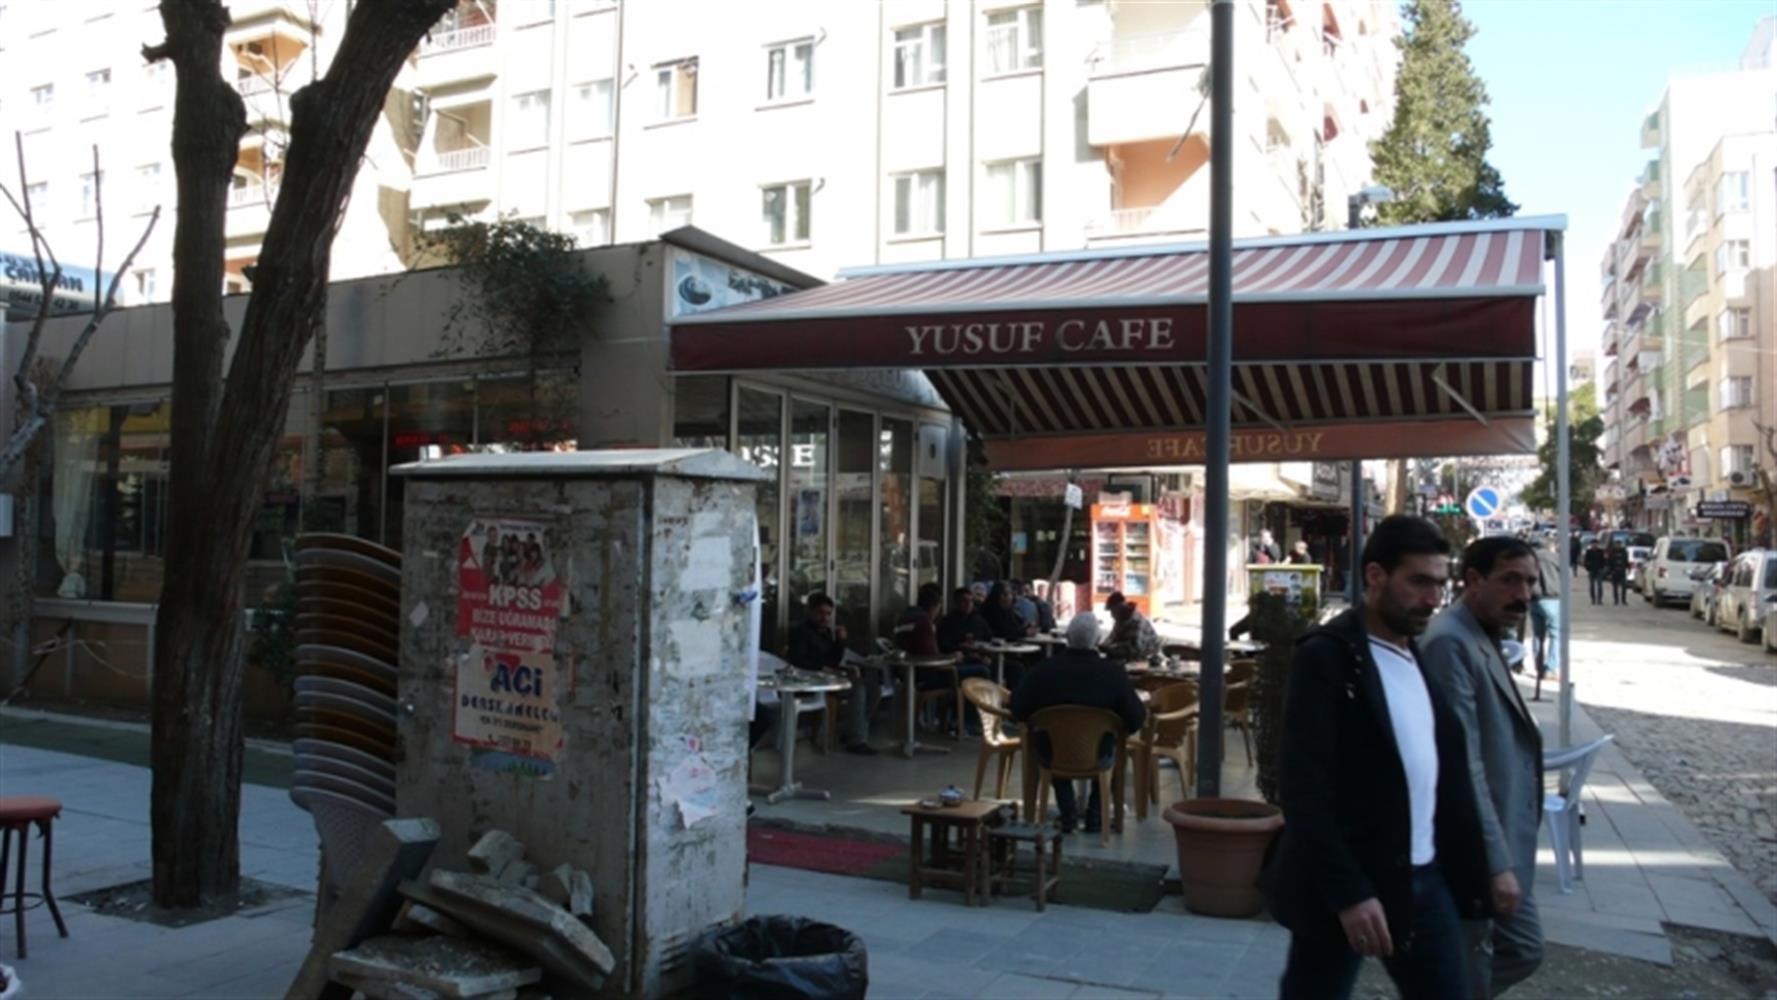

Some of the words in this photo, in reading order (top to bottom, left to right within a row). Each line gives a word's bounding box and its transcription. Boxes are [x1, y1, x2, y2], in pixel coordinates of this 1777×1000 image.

[904, 321, 1044, 355] YUSUF
[1055, 317, 1175, 350] CAFE
[489, 584, 542, 611] KPSS
